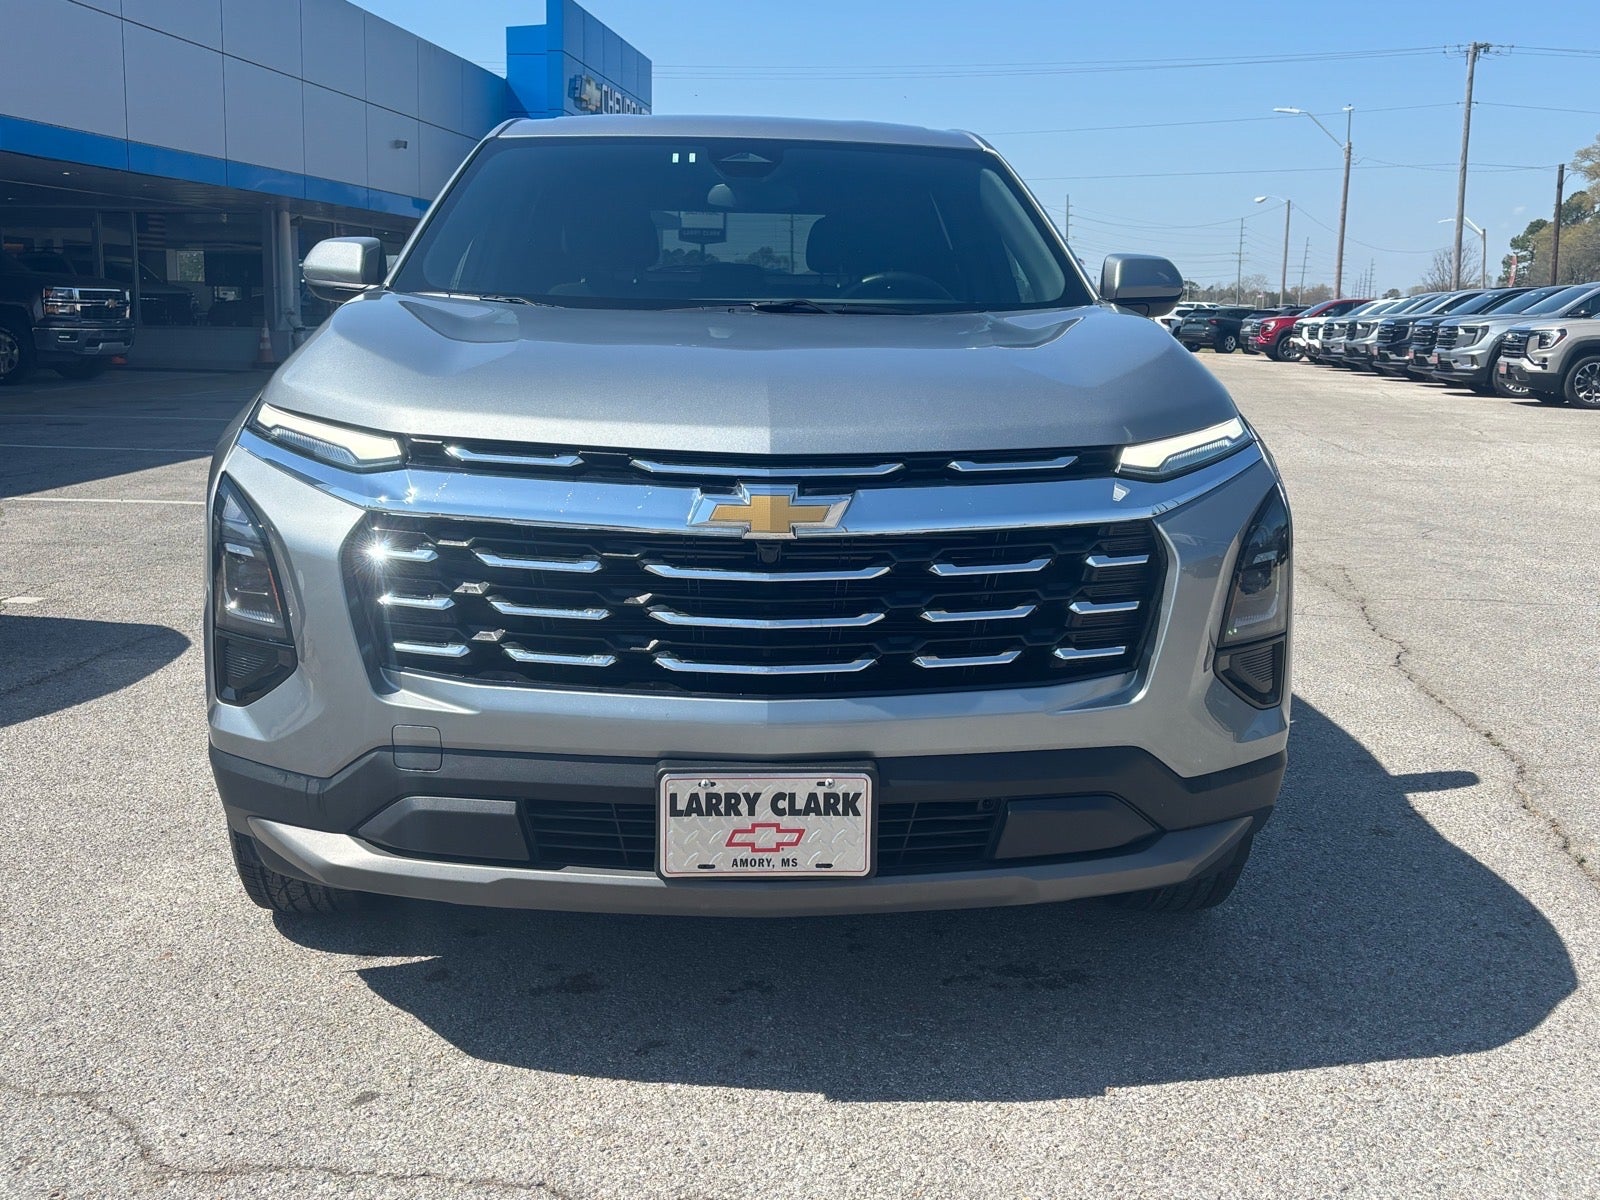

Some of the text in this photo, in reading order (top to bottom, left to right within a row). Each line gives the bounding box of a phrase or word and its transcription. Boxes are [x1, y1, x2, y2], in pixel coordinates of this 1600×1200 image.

[602, 84, 650, 115] CHEVR
[669, 792, 862, 817] LARRY CLARK
[731, 858, 798, 869] AMORY, MS
